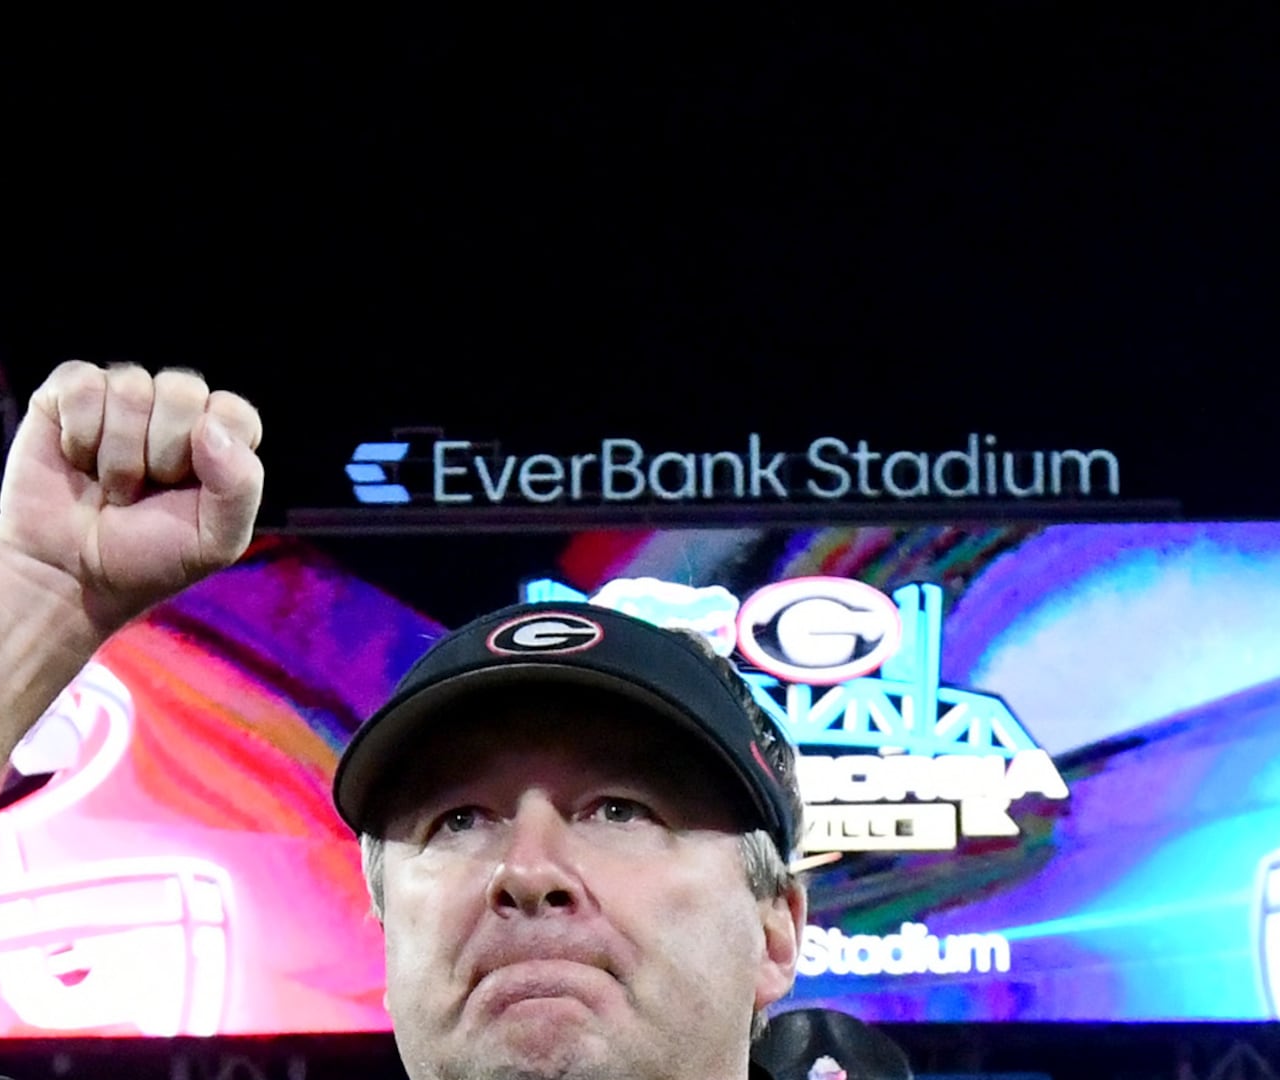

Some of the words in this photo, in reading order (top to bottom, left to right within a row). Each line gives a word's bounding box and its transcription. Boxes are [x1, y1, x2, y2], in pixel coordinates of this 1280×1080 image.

[433, 432, 788, 502] EverBank
[806, 432, 1121, 499] Stadium
[796, 921, 1011, 976] Stadium
